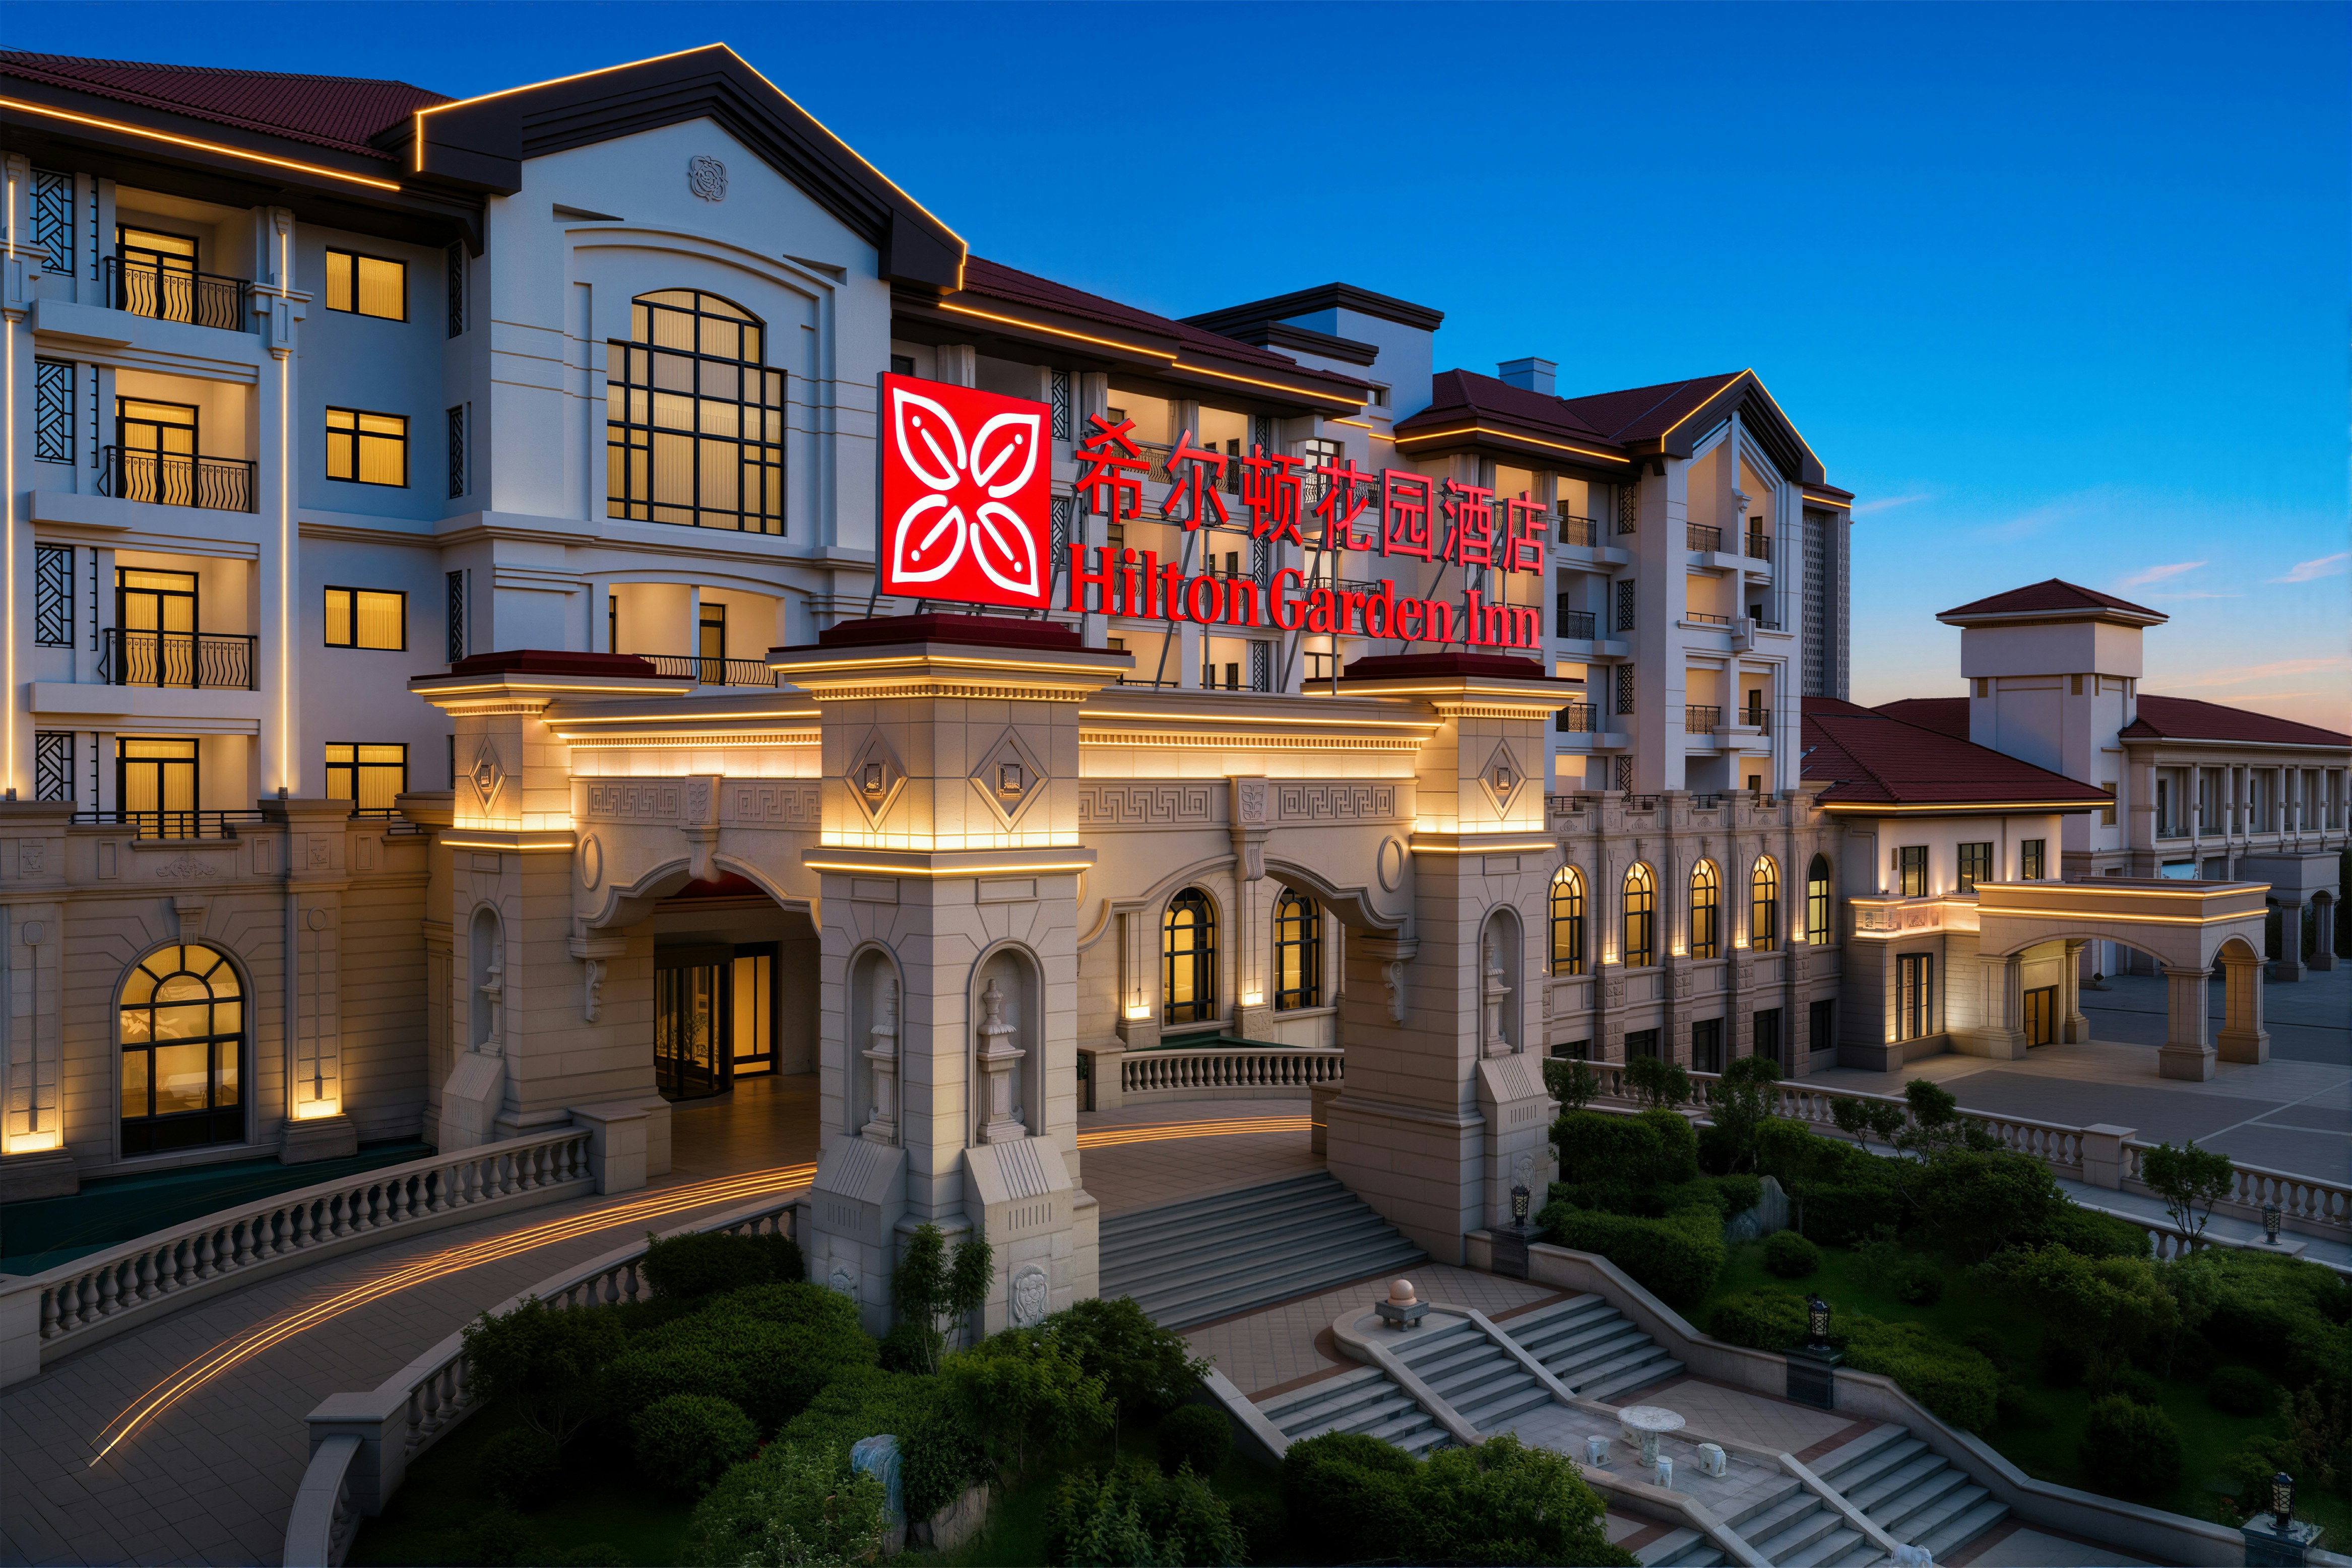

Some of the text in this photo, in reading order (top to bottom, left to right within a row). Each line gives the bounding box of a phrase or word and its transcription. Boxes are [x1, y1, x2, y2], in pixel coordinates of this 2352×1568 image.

[1073, 413, 1547, 576] 希尔顿花园酒店
[1067, 543, 1542, 649] Hilton Garden Inn
